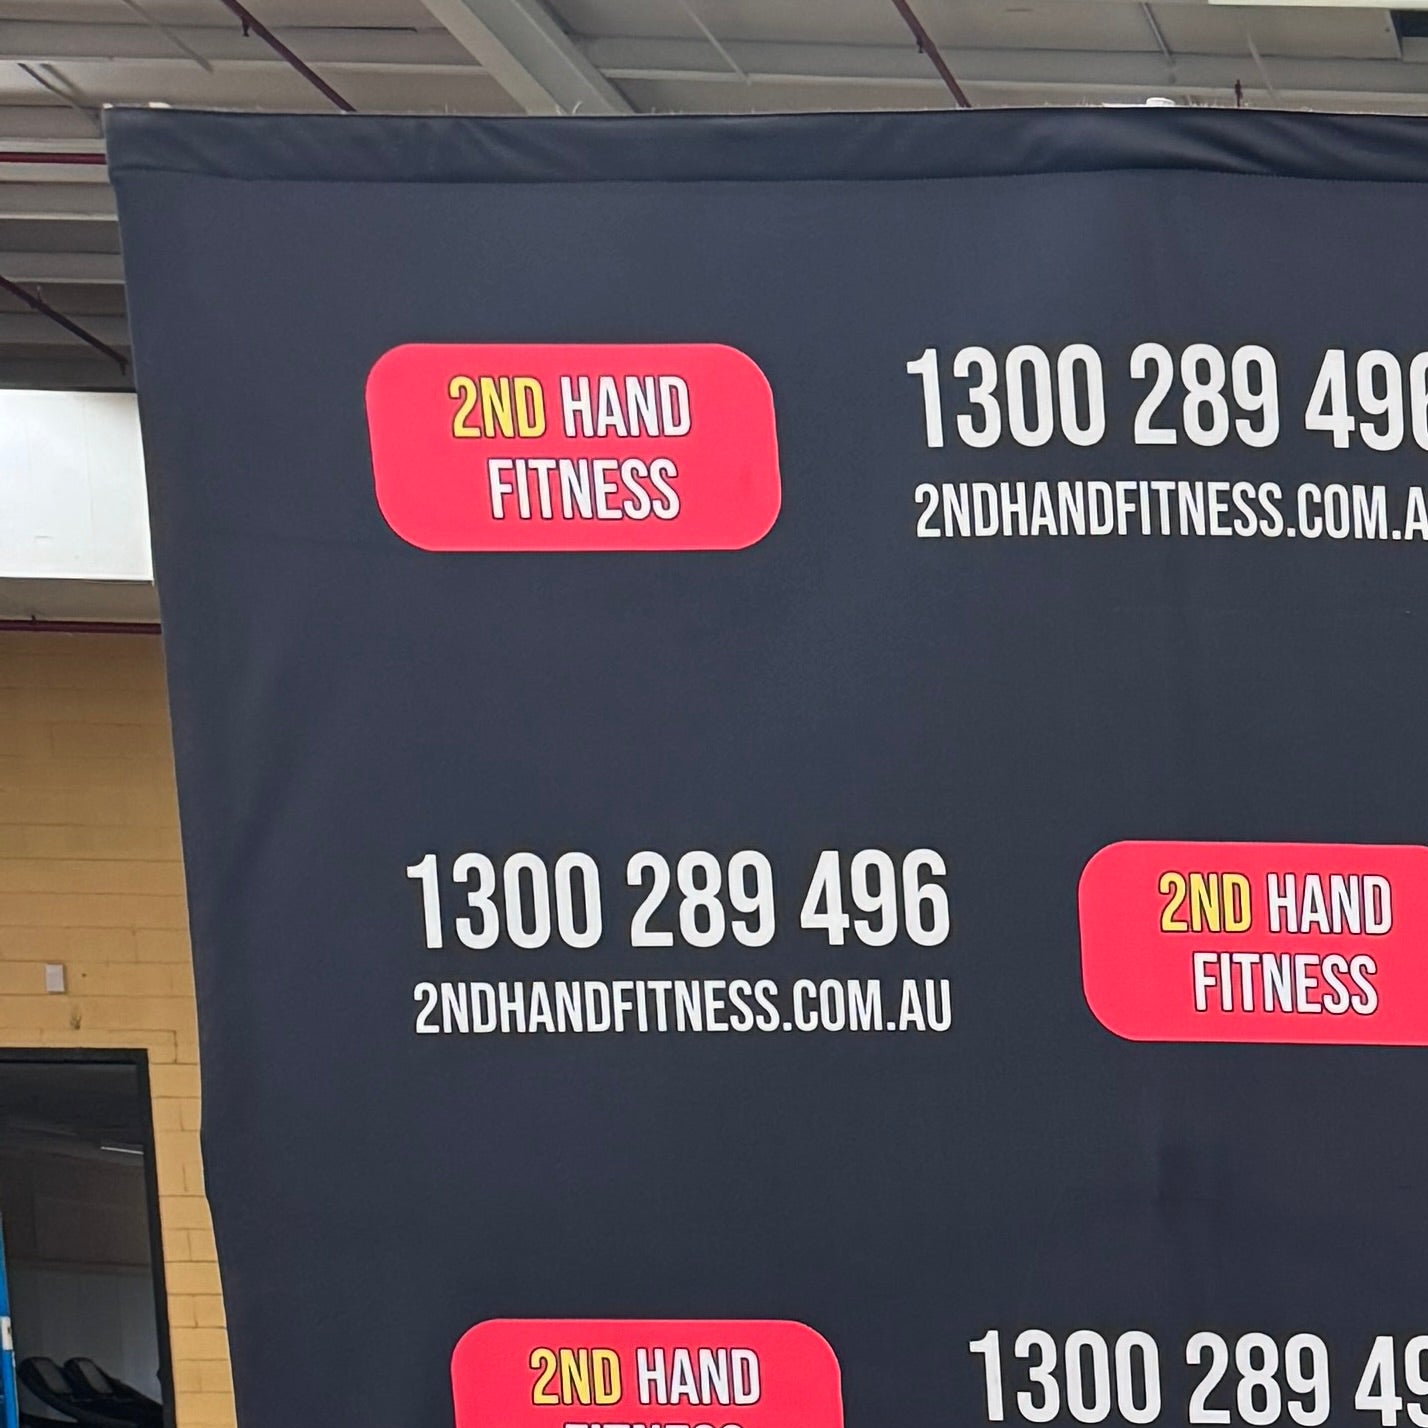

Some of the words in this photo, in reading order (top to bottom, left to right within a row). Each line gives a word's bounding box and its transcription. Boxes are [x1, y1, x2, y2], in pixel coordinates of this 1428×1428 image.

[449, 376, 546, 438] 2ND
[560, 376, 691, 437] HAND
[906, 343, 1106, 448] 1300
[1129, 342, 1280, 448] 289
[488, 458, 680, 520] FITNESS
[406, 851, 603, 950] 1300
[626, 849, 776, 948] 289
[800, 848, 950, 947] 496
[1159, 872, 1252, 932] 2ND
[1267, 873, 1392, 934] HAND
[413, 978, 952, 1034] 2NDHANDFITNESS.COM.AU
[1193, 952, 1378, 1015] FITNESS
[530, 1348, 621, 1405] 2ND
[637, 1348, 760, 1405] HAND
[969, 1329, 1162, 1424] 1300
[1185, 1331, 1331, 1427] 289
